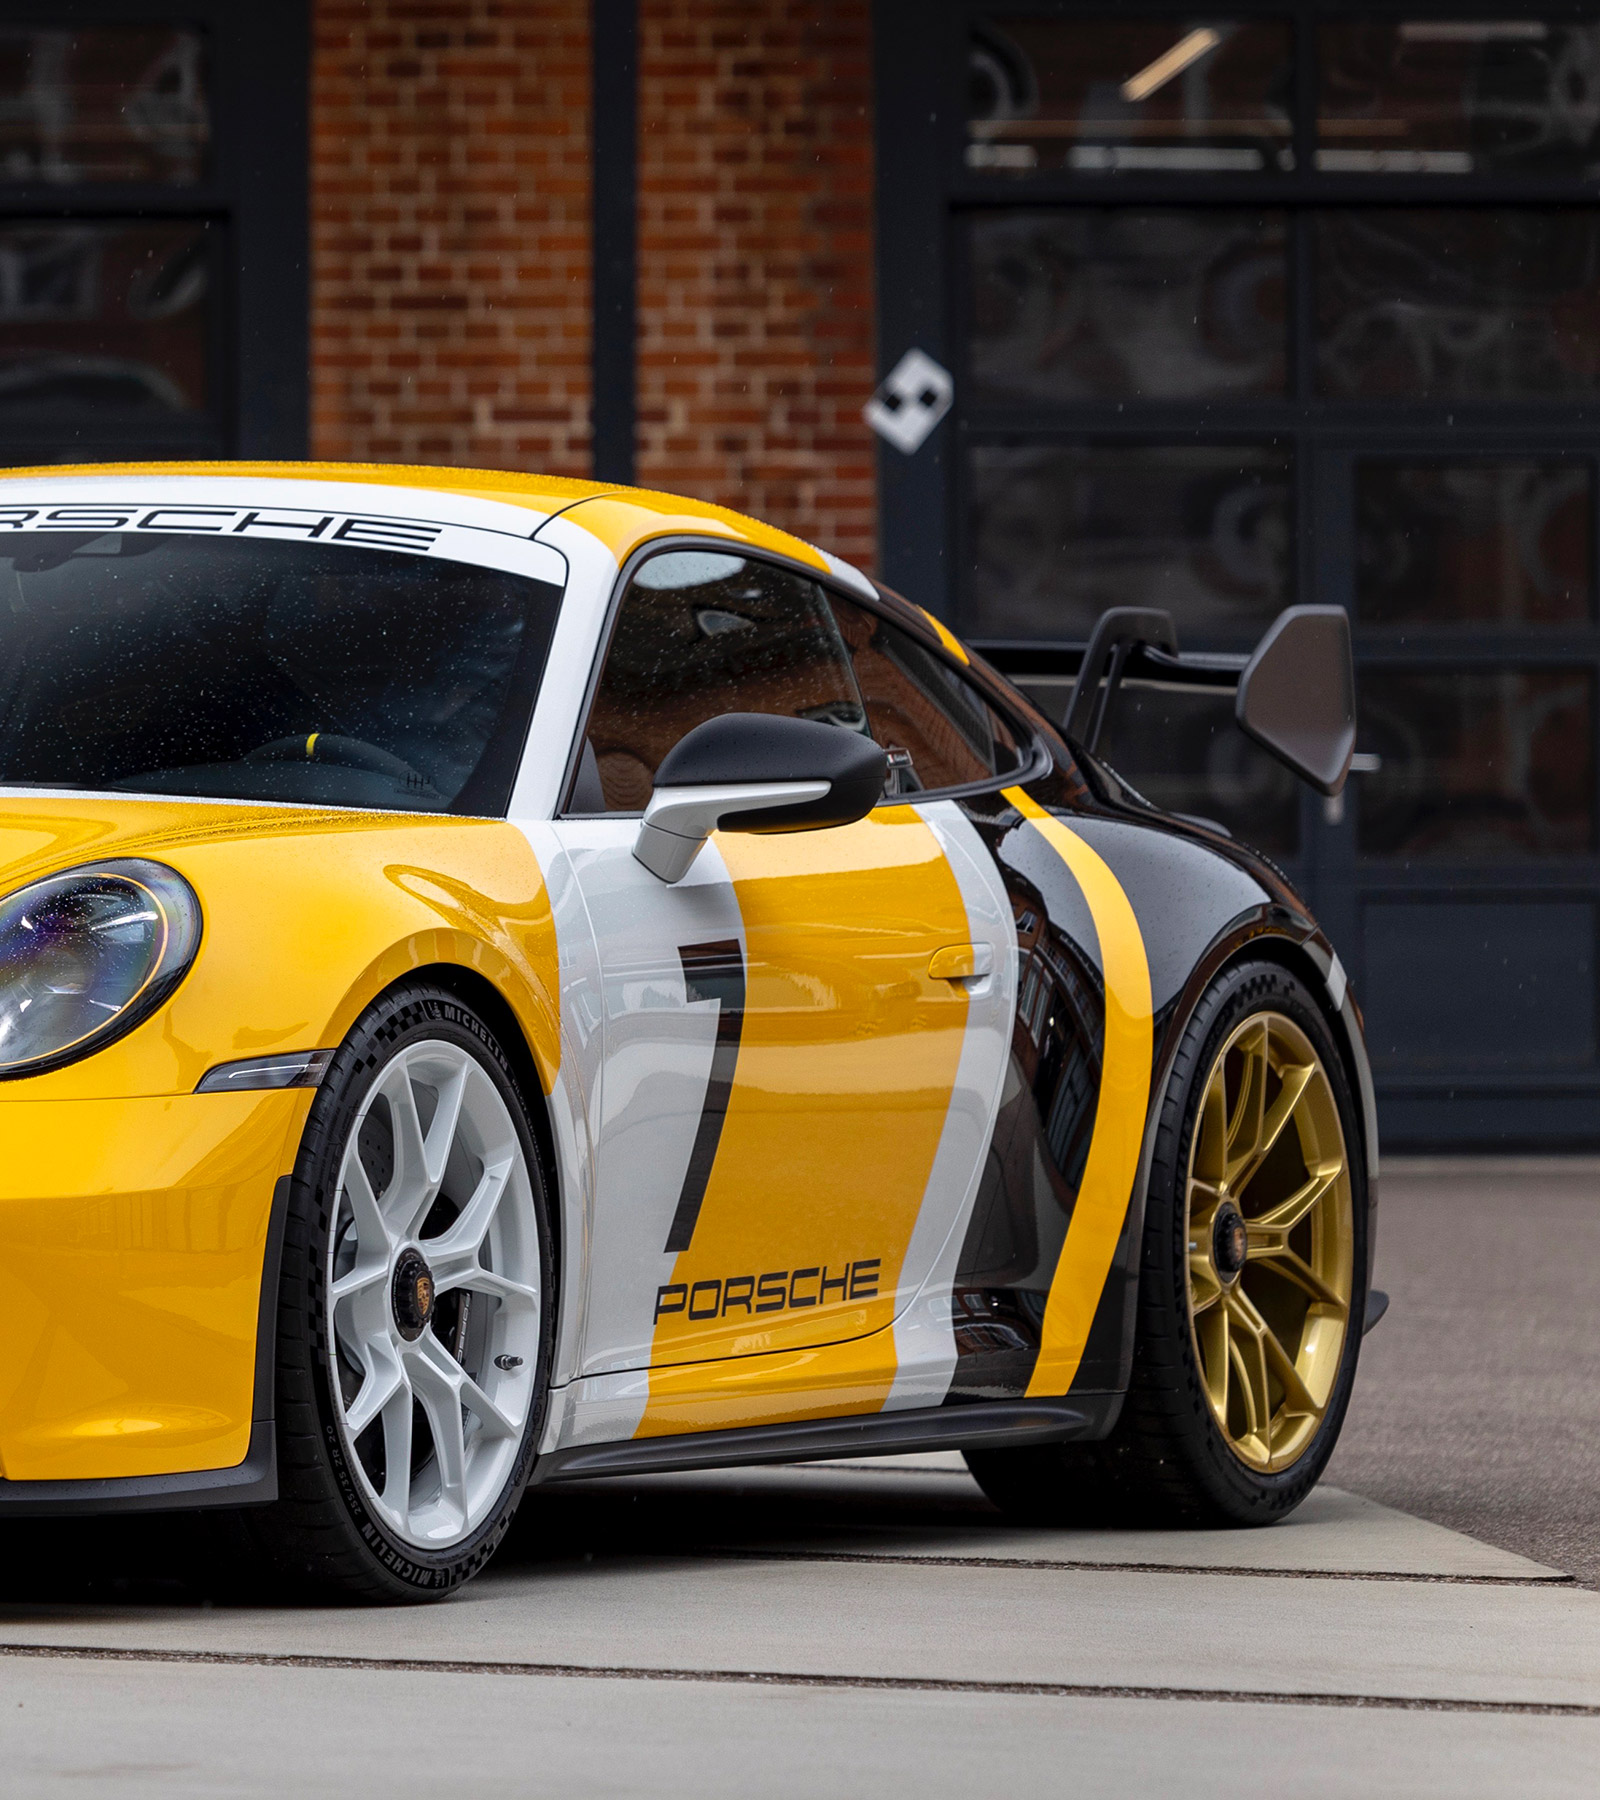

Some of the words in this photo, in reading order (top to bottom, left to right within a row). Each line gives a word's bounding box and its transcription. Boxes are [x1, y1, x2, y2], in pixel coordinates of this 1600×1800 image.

[444, 1004, 509, 1071] MICHELIN
[663, 938, 746, 1253] 7
[653, 1258, 882, 1325] PORSCHE
[458, 1293, 471, 1363] PORSC
[326, 1425, 338, 1443] 20
[332, 1449, 344, 1467] ZR
[339, 1471, 362, 1515] 255/35
[361, 1522, 432, 1585] MICHELIN
